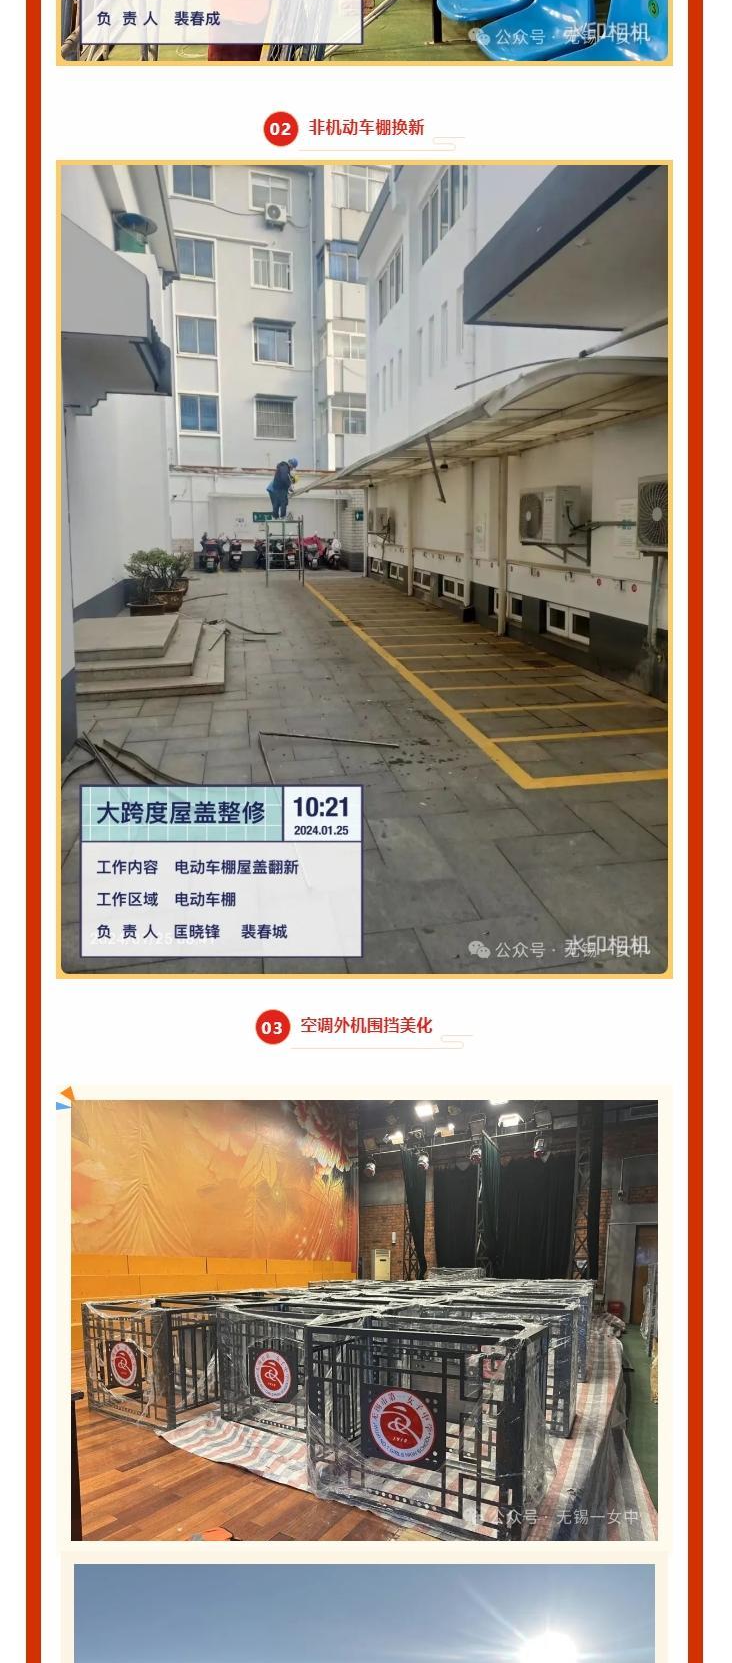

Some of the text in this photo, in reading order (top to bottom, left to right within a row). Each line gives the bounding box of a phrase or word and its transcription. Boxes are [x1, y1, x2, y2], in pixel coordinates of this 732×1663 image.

[270, 119, 424, 136] 02 非机动车棚换新
[261, 1017, 432, 1035] 03 空调外机围挡美化
